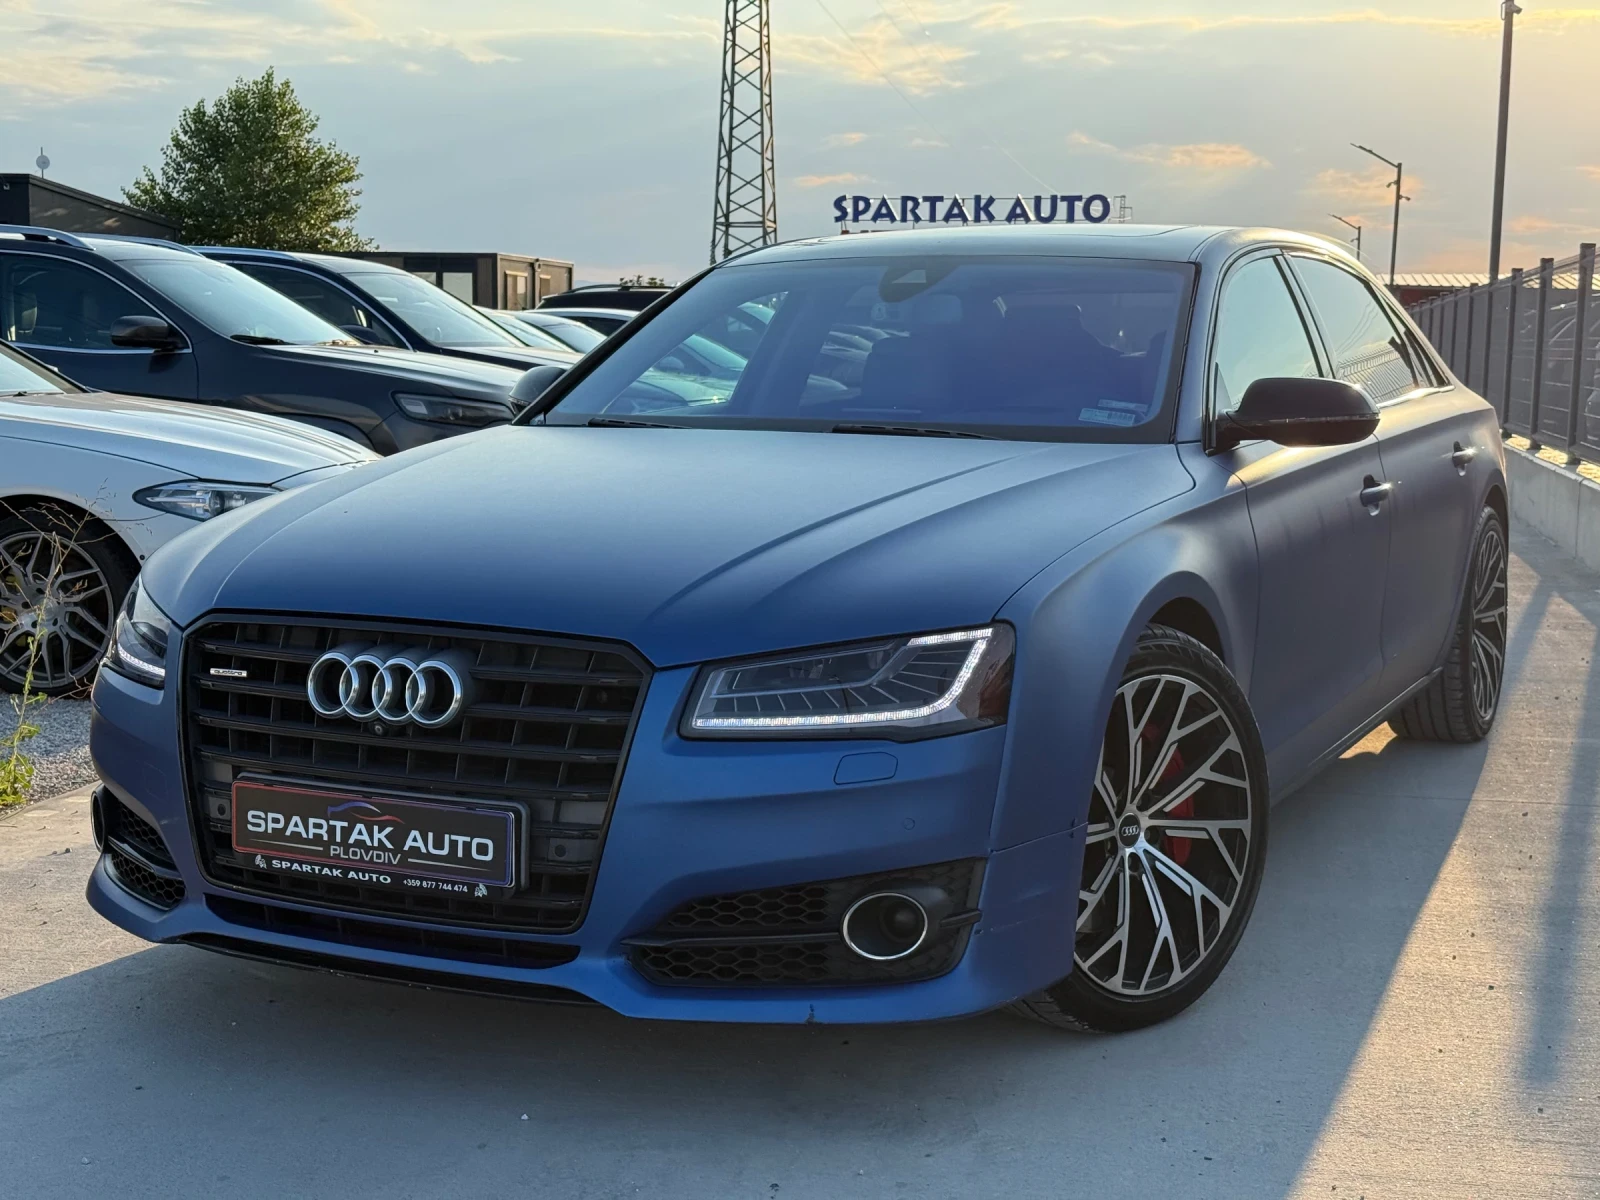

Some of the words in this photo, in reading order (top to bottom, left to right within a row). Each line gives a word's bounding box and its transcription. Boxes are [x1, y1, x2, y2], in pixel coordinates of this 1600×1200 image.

[833, 193, 996, 223] SPARTAK
[1005, 193, 1111, 223] AUTO
[246, 810, 394, 849] SPARTAK
[403, 829, 494, 862] AUTO
[330, 845, 401, 865] PLOVDIV
[271, 859, 343, 878] SPARTAK
[347, 870, 392, 884] AUTO
[403, 878, 421, 887] +359
[422, 880, 436, 889] 877
[438, 882, 452, 891] 744
[453, 884, 468, 893] 474
